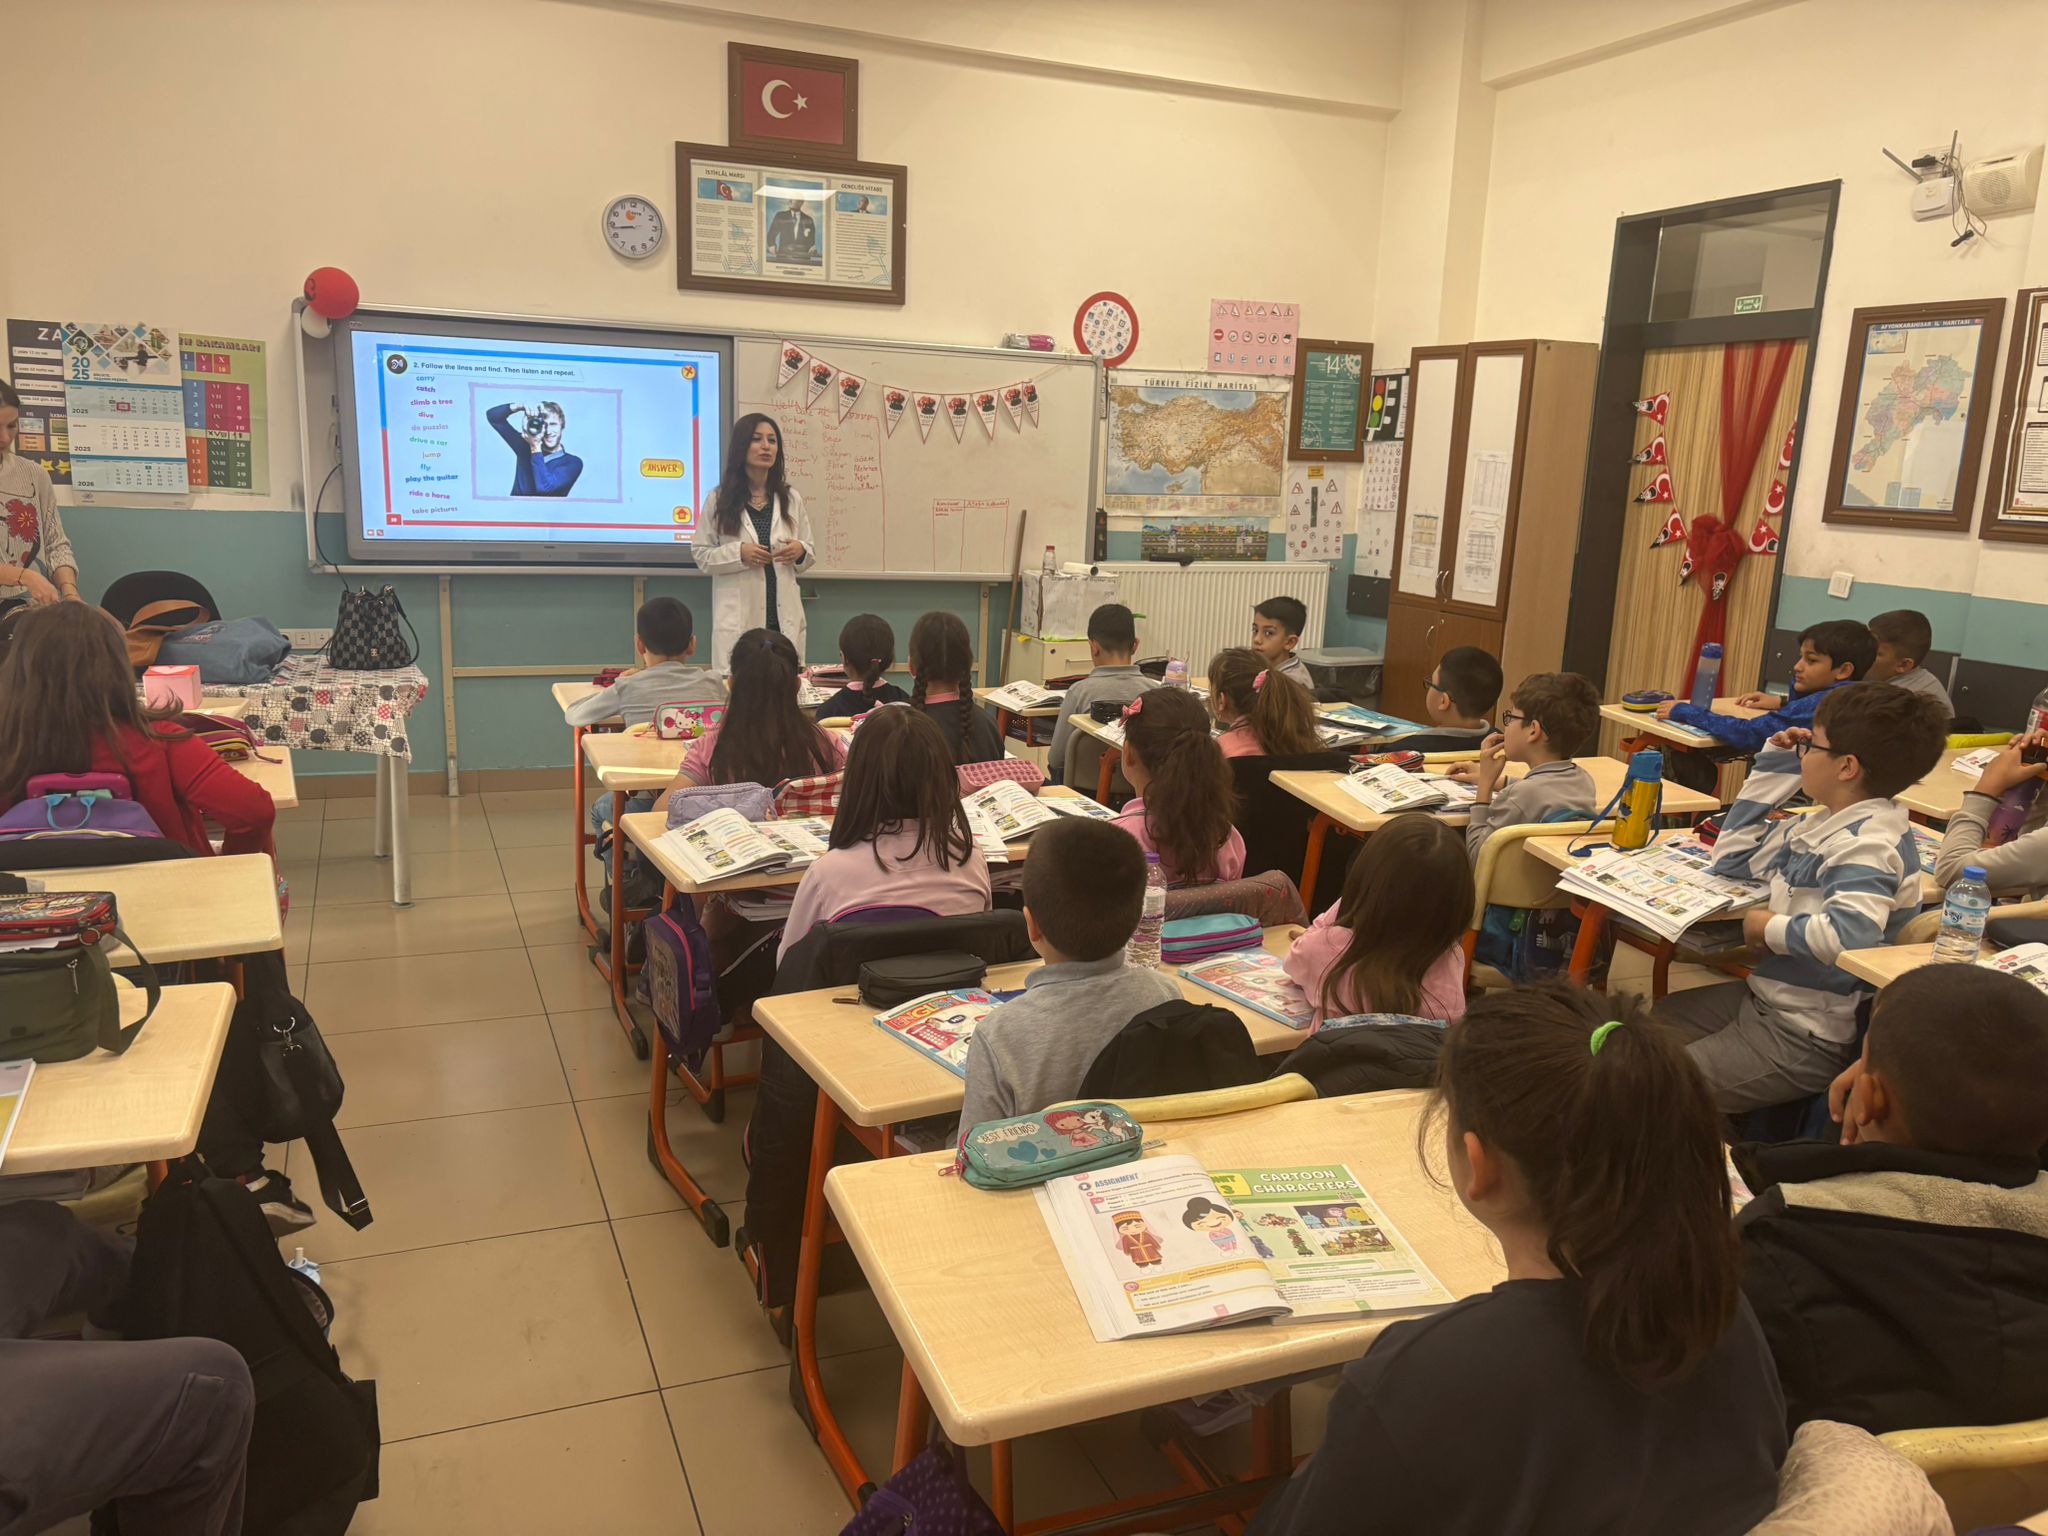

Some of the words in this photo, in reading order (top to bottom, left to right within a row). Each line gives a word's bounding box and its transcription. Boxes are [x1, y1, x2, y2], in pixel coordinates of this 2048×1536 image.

[72, 356, 90, 368] 20
[1324, 355, 1340, 374] 14
[72, 369, 90, 380] 25
[553, 369, 576, 377] repeat.
[416, 385, 436, 394] catch
[1144, 378, 1180, 388] TÜRKİYE
[1185, 380, 1212, 389] FİZİKİ
[1217, 381, 1258, 391] HARİTASI
[409, 436, 428, 444] drive
[420, 464, 431, 472] fly
[647, 464, 678, 474] ANSWER
[436, 474, 459, 482] guitar
[408, 490, 424, 498] ride
[982, 1132, 1000, 1143] BEST
[1002, 1124, 1036, 1138] FRIENDS!
[1094, 1172, 1139, 1188] ASSIGNMENT
[1260, 1170, 1337, 1182] CARTOON
[1253, 1180, 1360, 1194] CHARACTERS
